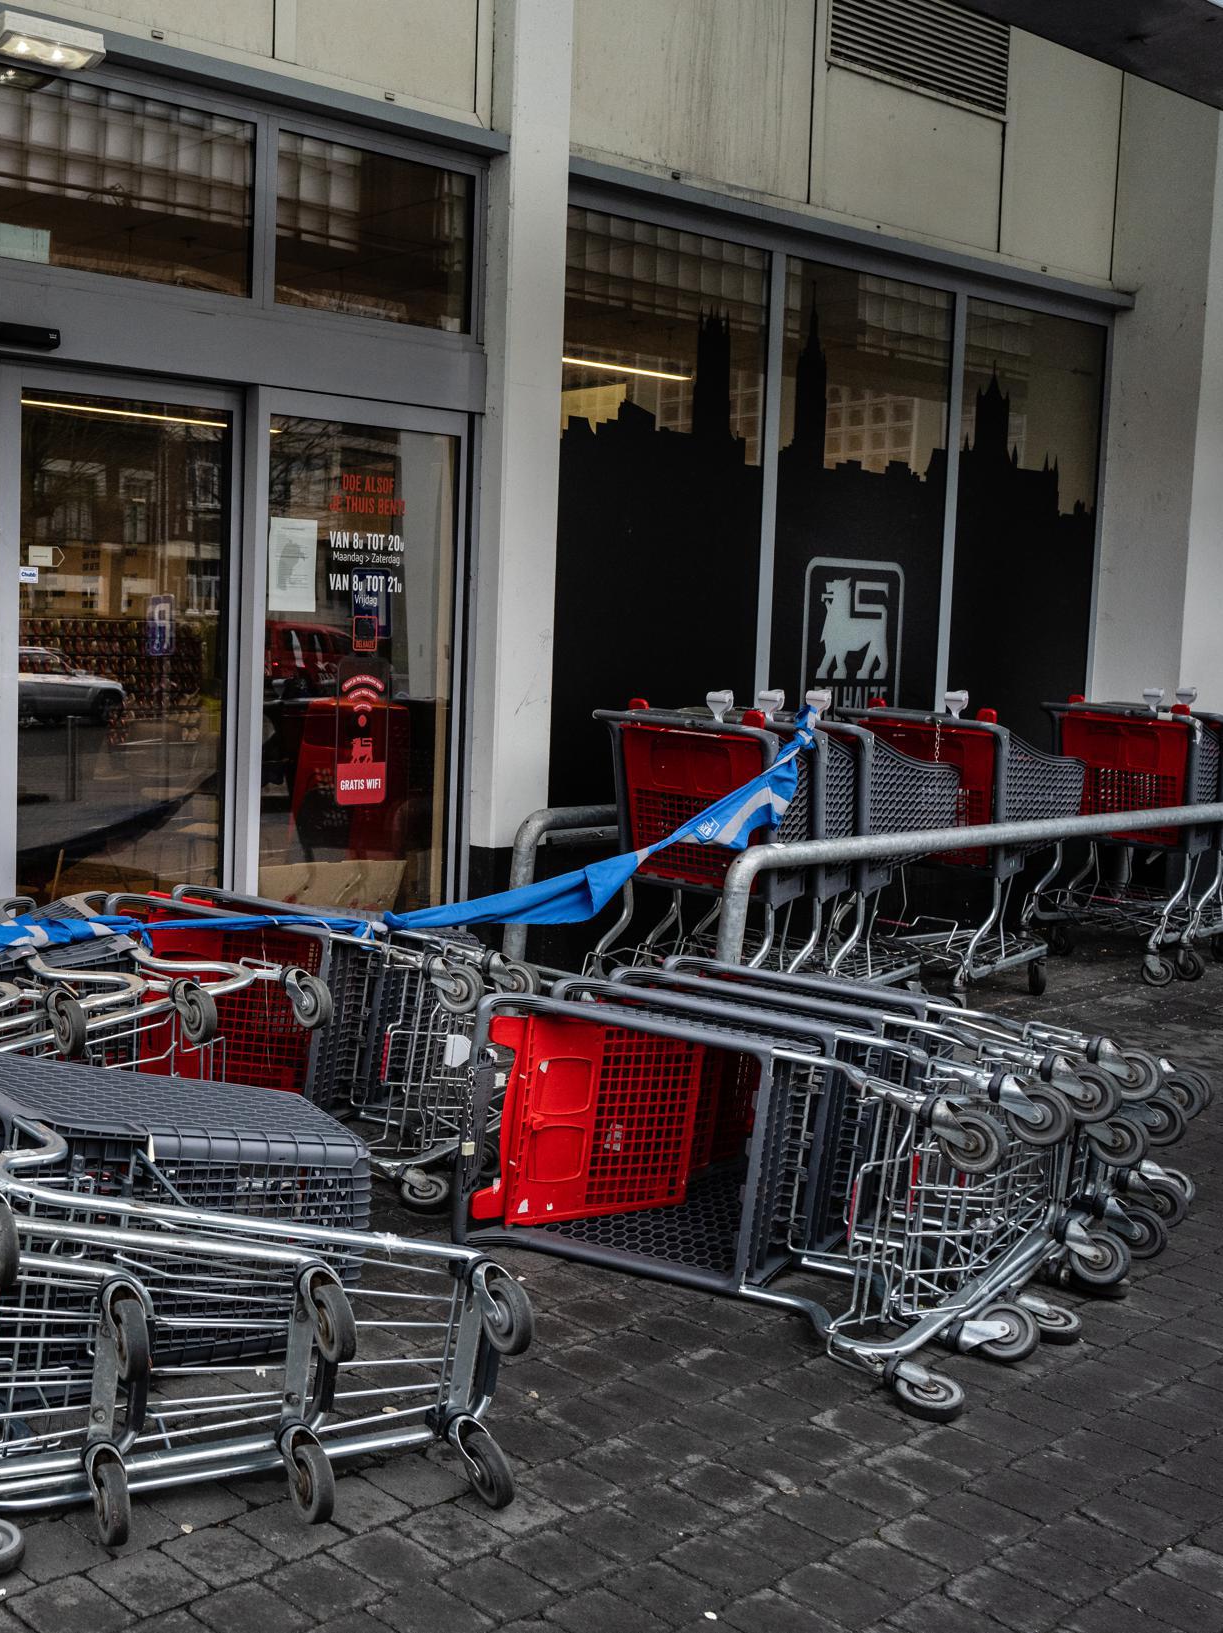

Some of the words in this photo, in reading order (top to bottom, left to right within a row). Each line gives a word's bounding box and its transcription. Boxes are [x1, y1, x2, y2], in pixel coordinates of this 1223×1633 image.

[342, 472, 361, 493] DOE
[365, 476, 394, 493] ALSOF
[329, 496, 342, 513] JE
[346, 497, 375, 514] THUIS
[330, 531, 350, 549] VAN
[366, 533, 385, 551] TOT
[332, 552, 364, 565] Maandag
[371, 553, 401, 566] Zaterdag
[329, 574, 349, 591] VAN
[366, 575, 385, 592] TOT
[354, 594, 378, 607] Vrijdag
[340, 779, 364, 791] GRATIS
[367, 778, 381, 790] WIFI
